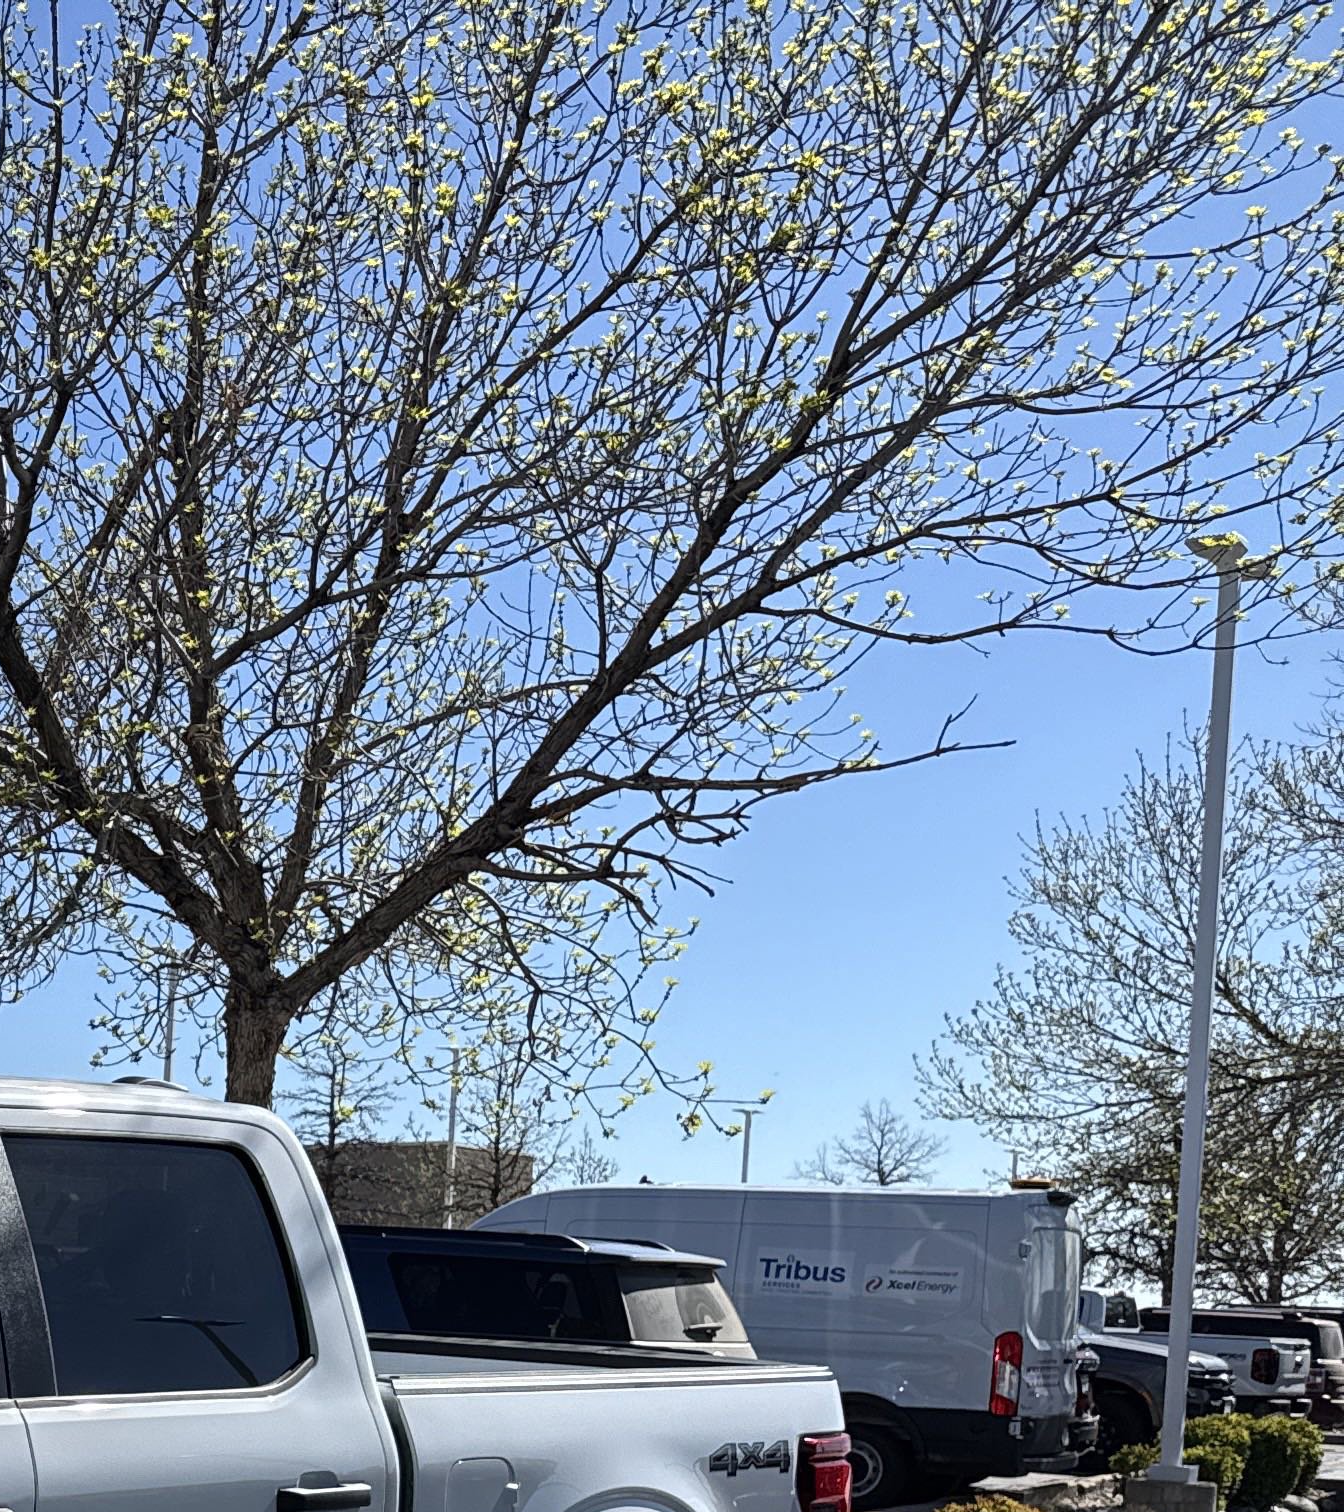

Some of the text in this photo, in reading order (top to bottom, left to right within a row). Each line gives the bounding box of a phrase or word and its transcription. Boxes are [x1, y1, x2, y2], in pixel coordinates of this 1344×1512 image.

[760, 1255, 846, 1283] Tribus
[887, 1280, 957, 1295] Xcel Energy
